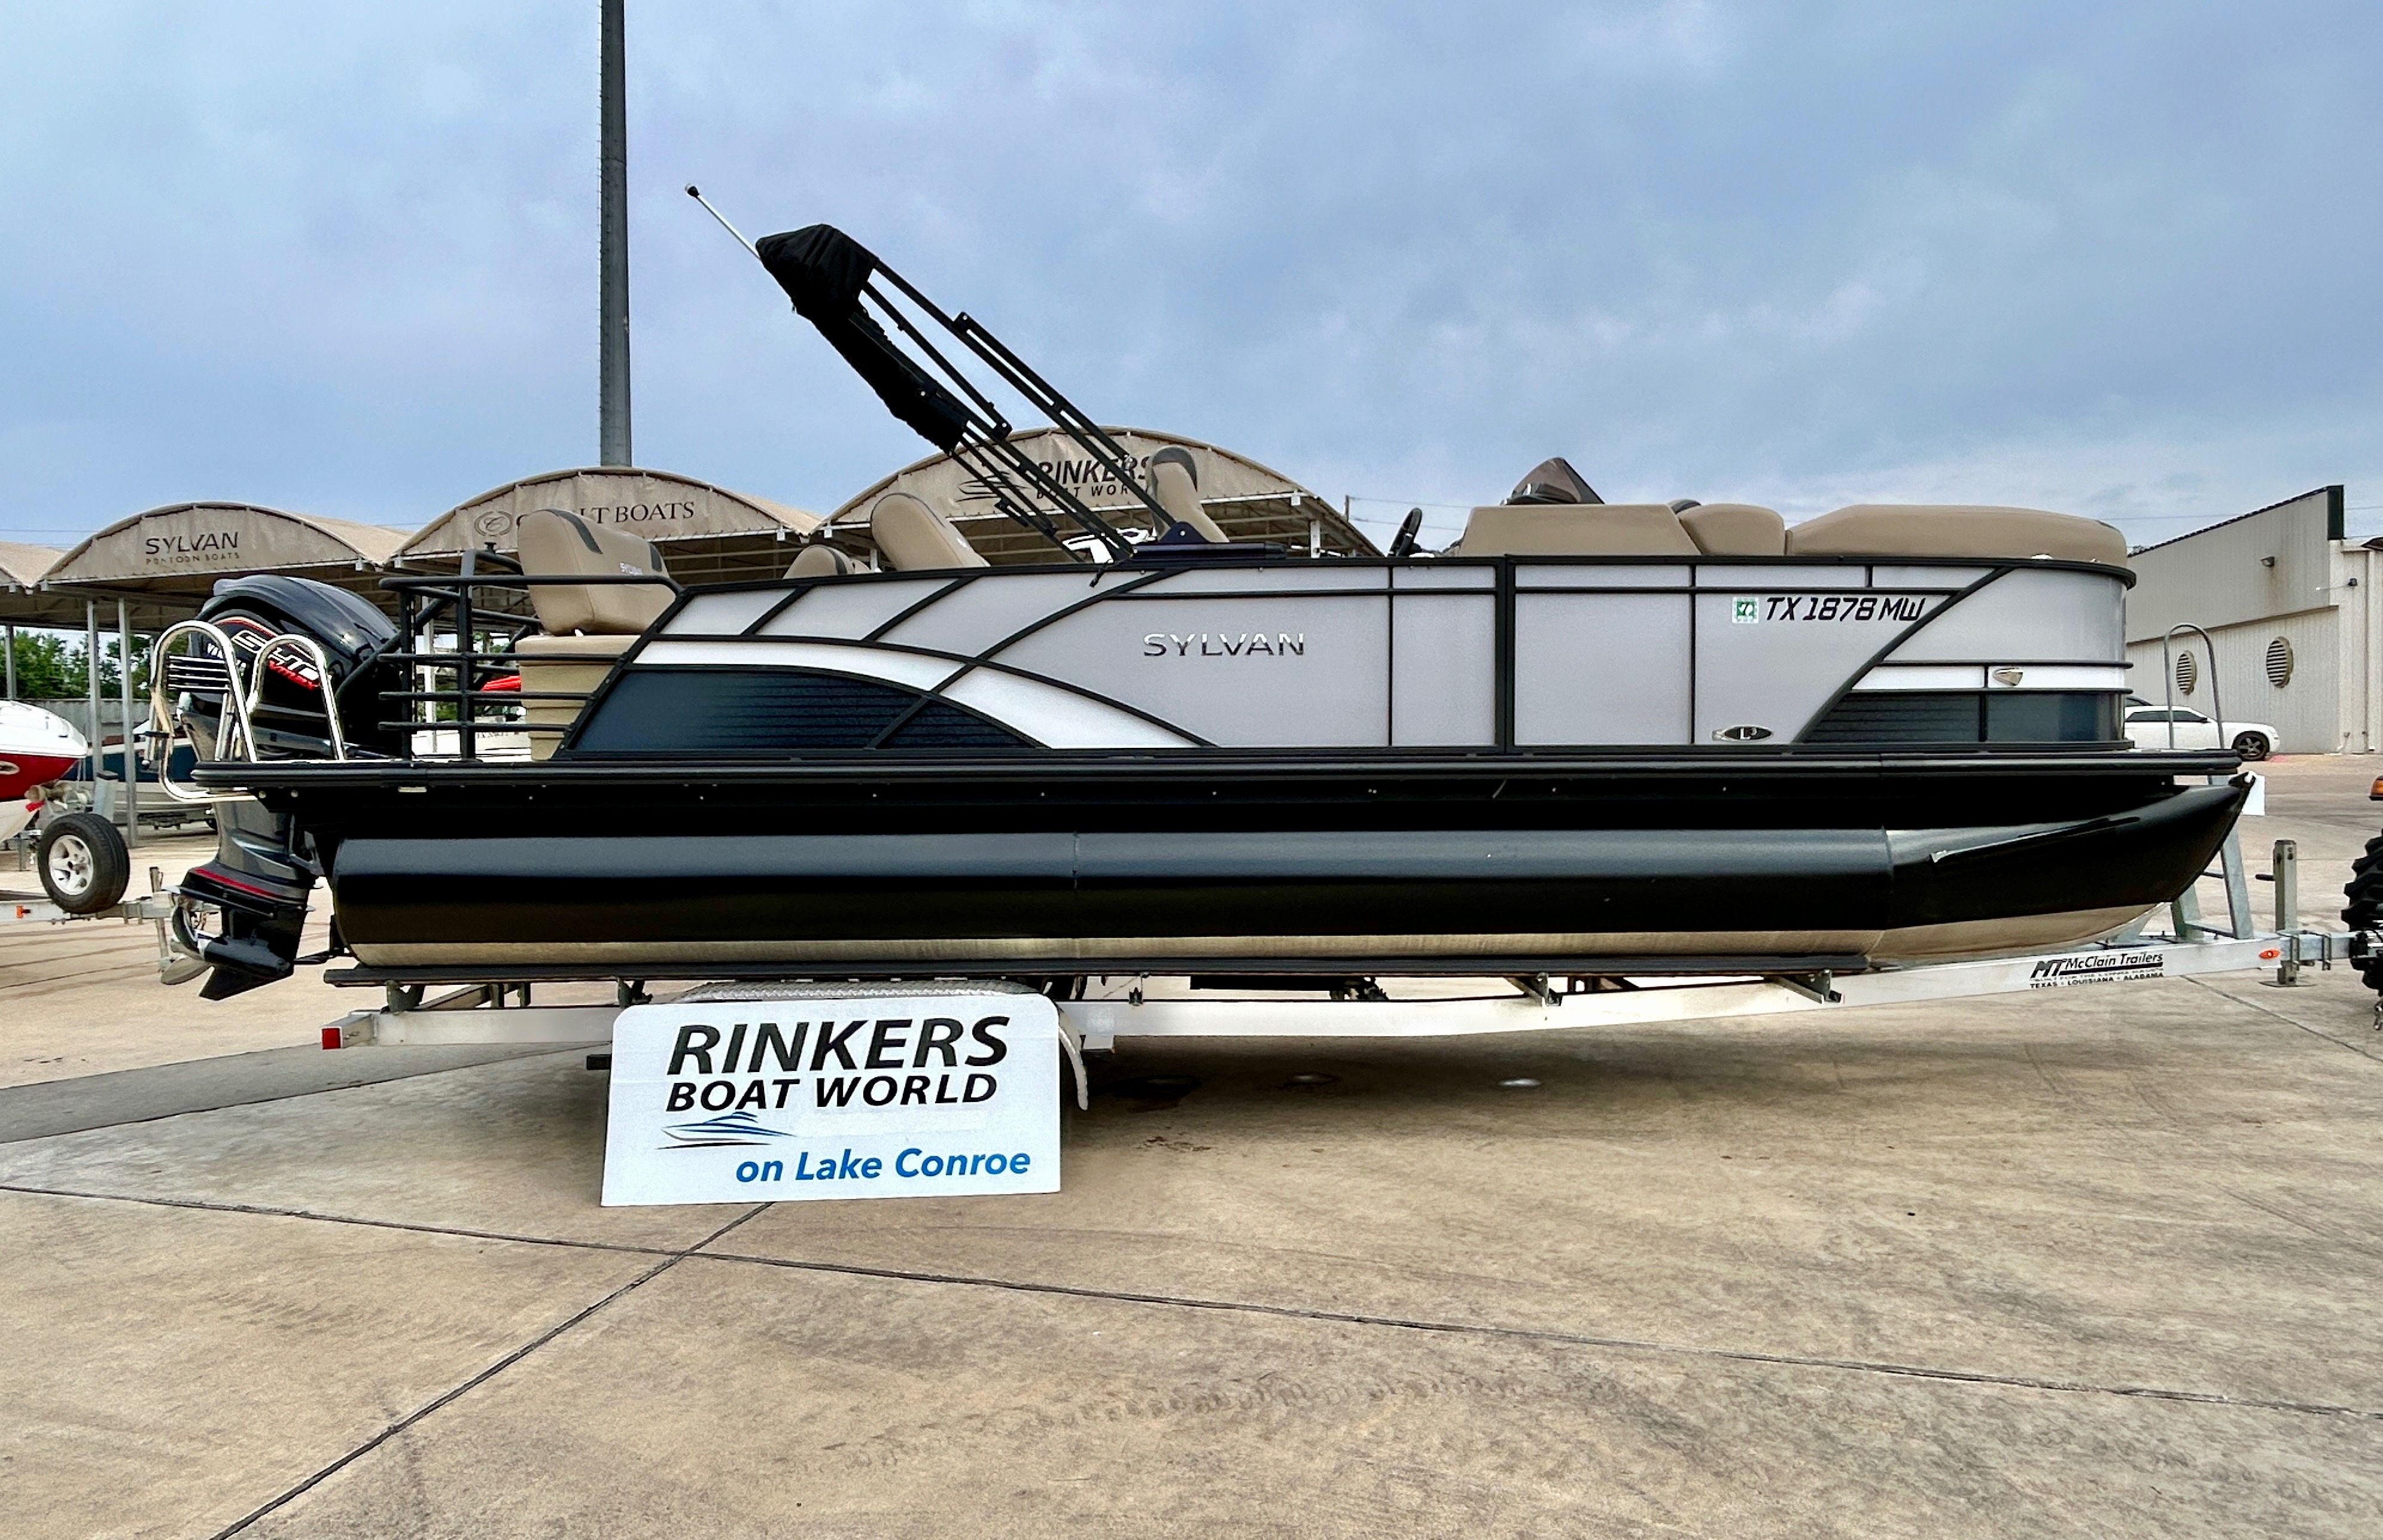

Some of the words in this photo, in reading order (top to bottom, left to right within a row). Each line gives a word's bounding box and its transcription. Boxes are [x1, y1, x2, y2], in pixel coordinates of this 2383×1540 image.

[1091, 483, 1148, 497] WOR
[615, 501, 695, 523] BOATS
[145, 532, 238, 554] SYLVAN
[205, 552, 239, 561] BOATS
[1766, 596, 1801, 620] TX
[1803, 596, 1877, 622] 1878
[1878, 596, 1927, 621] MW
[1143, 632, 1304, 656] SYLVAN
[2065, 955, 2116, 969] McClain
[2120, 952, 2163, 965] Trailers
[2068, 977, 2114, 985] LOUISIANA
[2123, 972, 2163, 981] ALABAMA
[667, 1016, 1010, 1075] RINKERS
[666, 1079, 800, 1112] BOAT
[815, 1073, 997, 1108] WORLD
[736, 1159, 784, 1183] on
[796, 1148, 882, 1180] Lake
[895, 1148, 1031, 1177] Conroe
